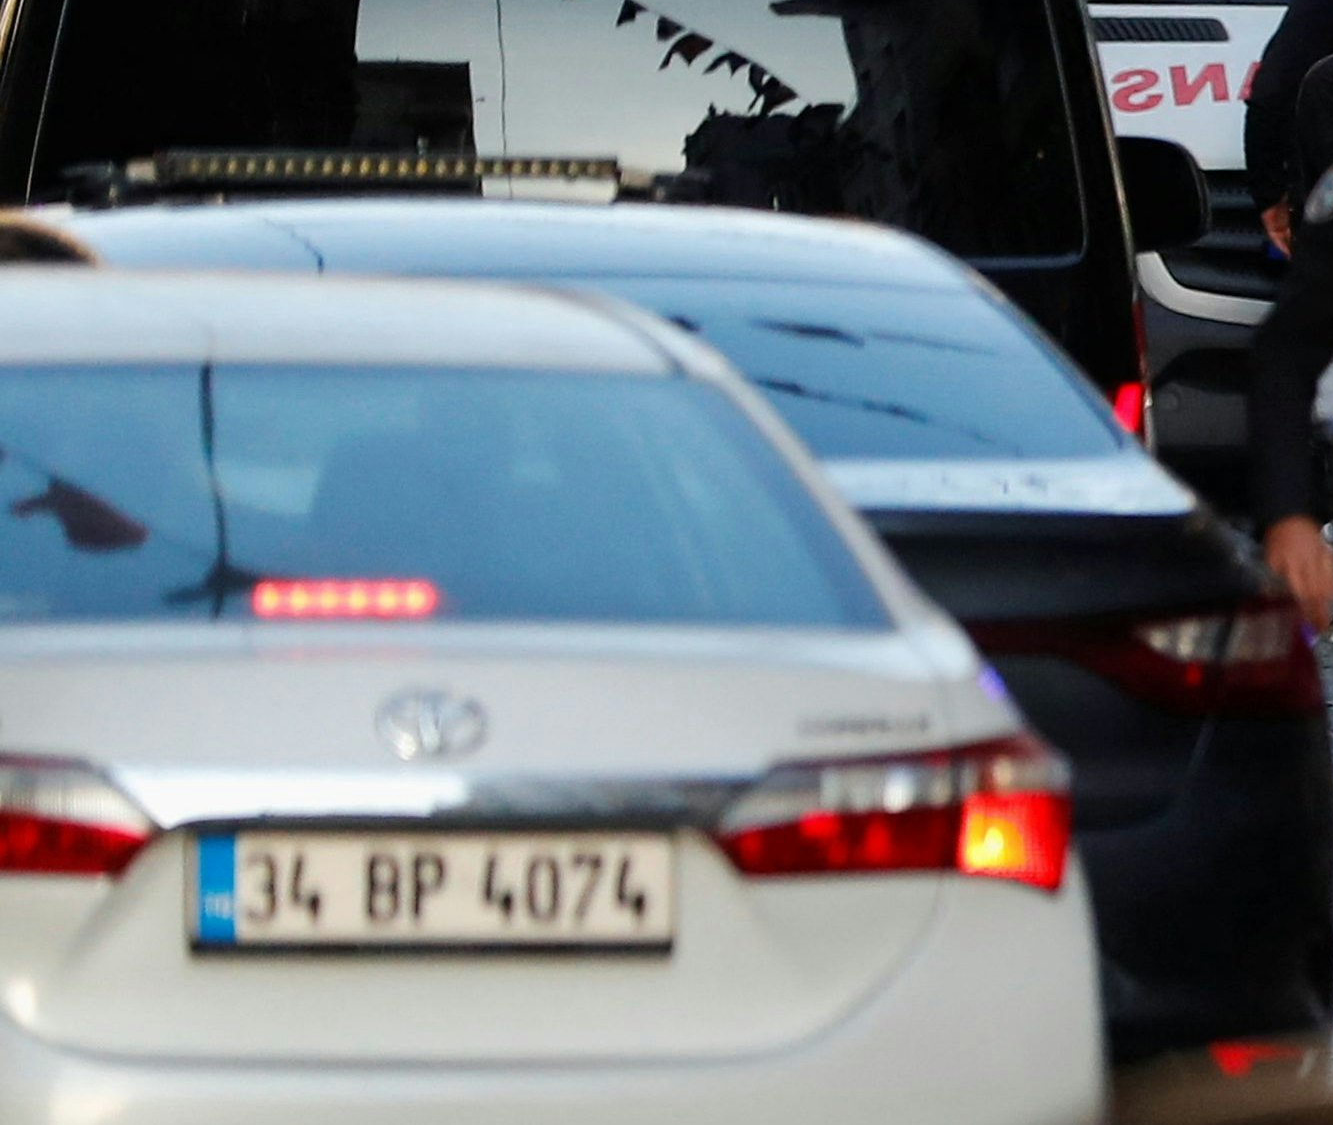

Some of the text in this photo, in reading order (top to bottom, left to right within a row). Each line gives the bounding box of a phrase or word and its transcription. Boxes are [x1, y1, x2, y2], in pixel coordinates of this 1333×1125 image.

[246, 852, 646, 922] 34 BP 4074
